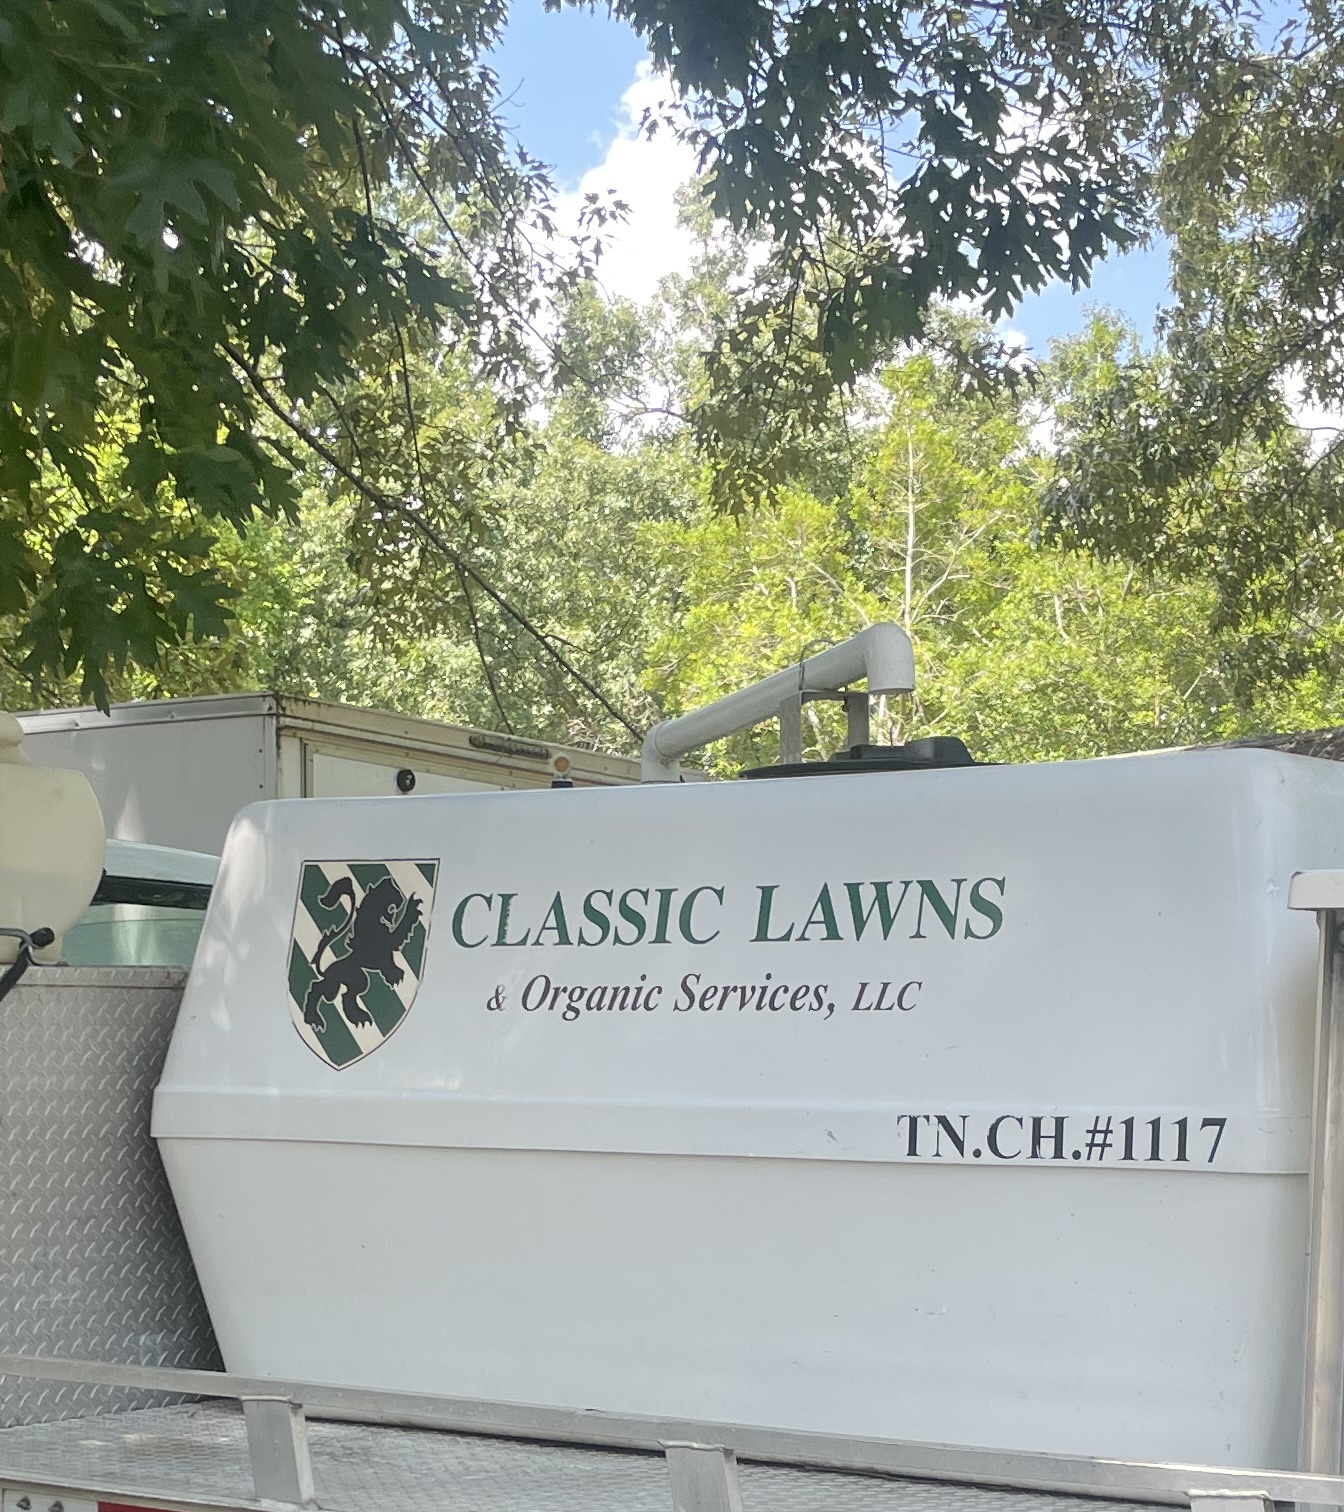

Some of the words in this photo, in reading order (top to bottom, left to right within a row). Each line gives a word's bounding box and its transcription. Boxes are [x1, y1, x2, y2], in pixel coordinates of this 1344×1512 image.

[451, 885, 726, 950] CLASSIC
[748, 875, 1008, 943] LAWNS
[485, 984, 509, 1012] &
[520, 973, 664, 1022] Organic
[672, 972, 837, 1022] Services,
[850, 980, 925, 1012] LLC
[895, 1113, 1229, 1166] TN.CH.#1117
